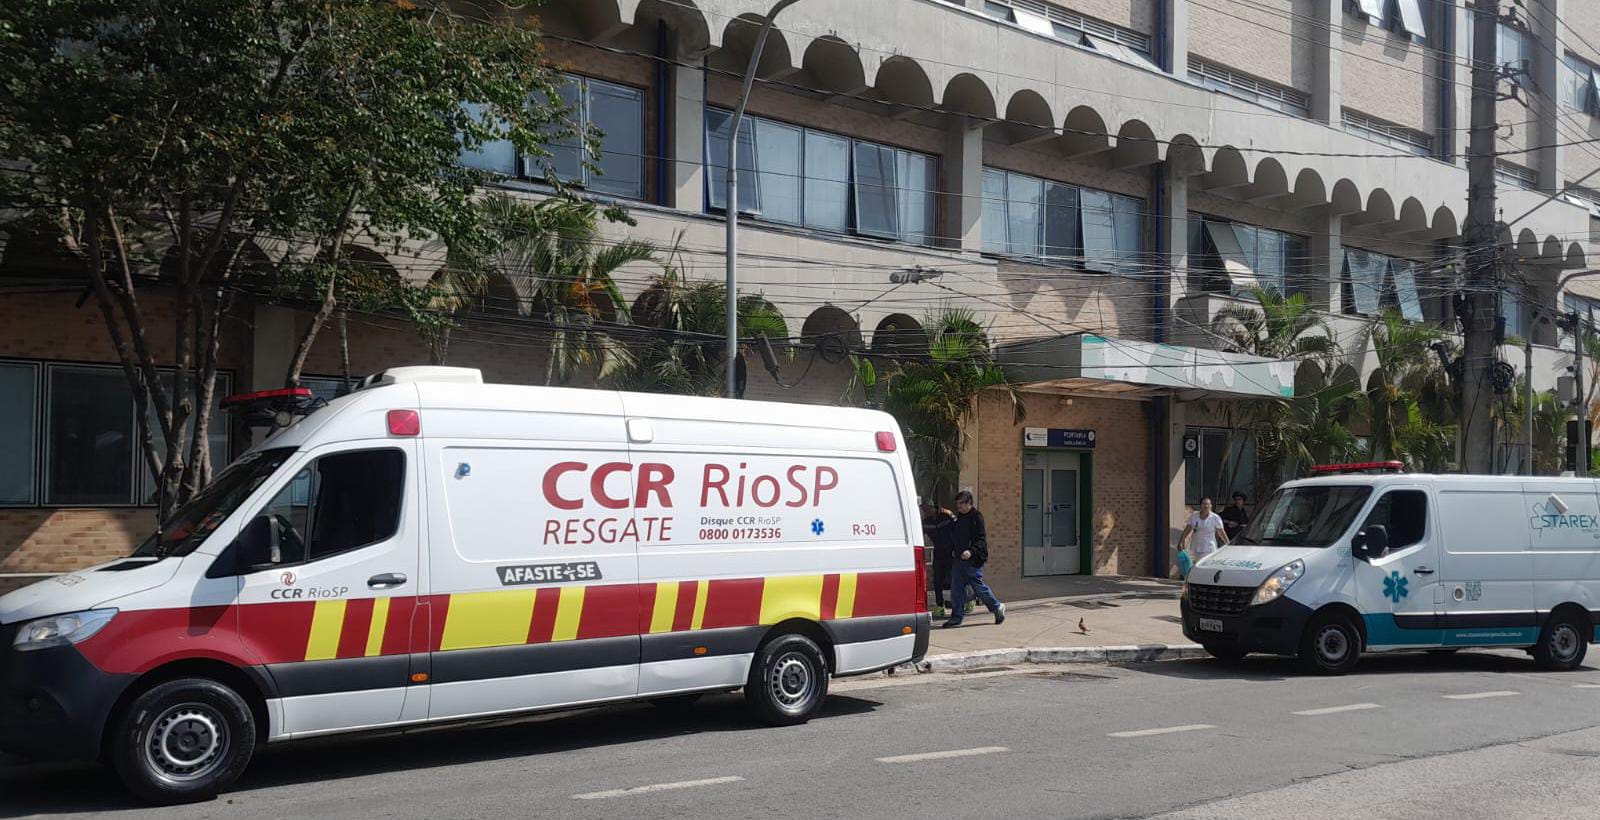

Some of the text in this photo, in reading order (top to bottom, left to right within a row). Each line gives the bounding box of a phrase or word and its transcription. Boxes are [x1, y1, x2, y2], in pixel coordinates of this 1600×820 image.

[542, 461, 838, 510] CCR RioSP
[700, 516, 781, 526] Disque CCR RioSP
[1541, 514, 1599, 528] STAREX
[543, 517, 673, 545] RESGATE
[699, 528, 781, 540] 0800 0173536
[852, 524, 876, 535] R-30
[271, 586, 348, 600] CCR RioSP
